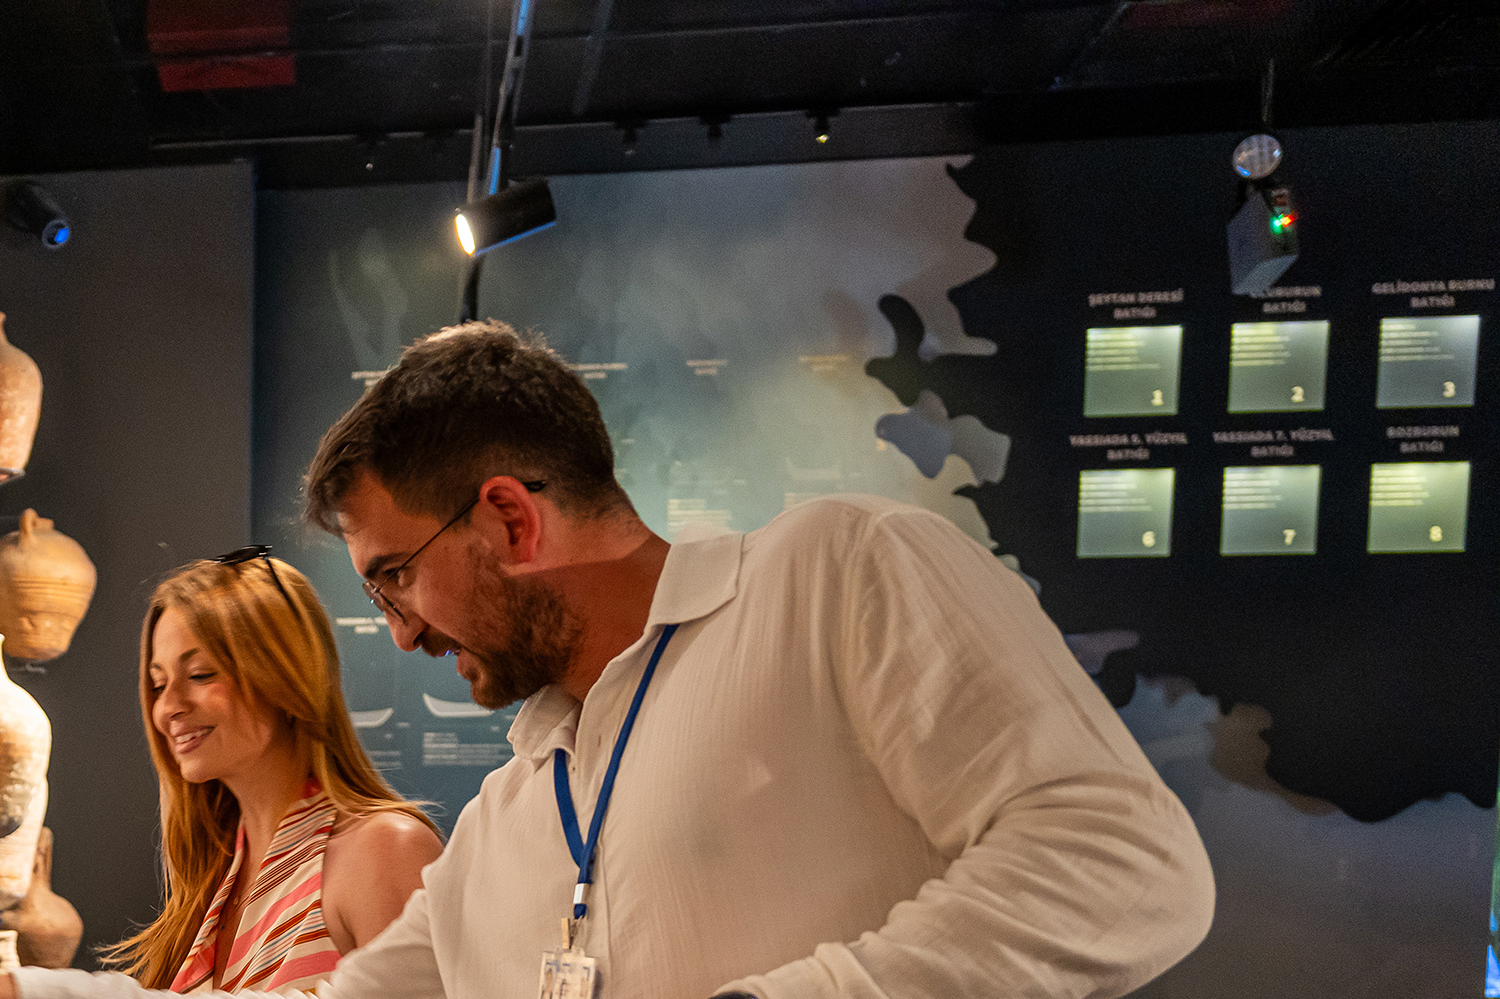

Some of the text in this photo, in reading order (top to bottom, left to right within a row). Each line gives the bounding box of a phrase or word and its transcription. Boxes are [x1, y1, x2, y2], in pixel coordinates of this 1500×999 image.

[1151, 389, 1164, 406] 1
[1291, 385, 1304, 403] 2
[1443, 381, 1455, 398] 3
[1141, 531, 1156, 548] 6
[1283, 529, 1297, 546] 7
[1429, 525, 1443, 542] 8
